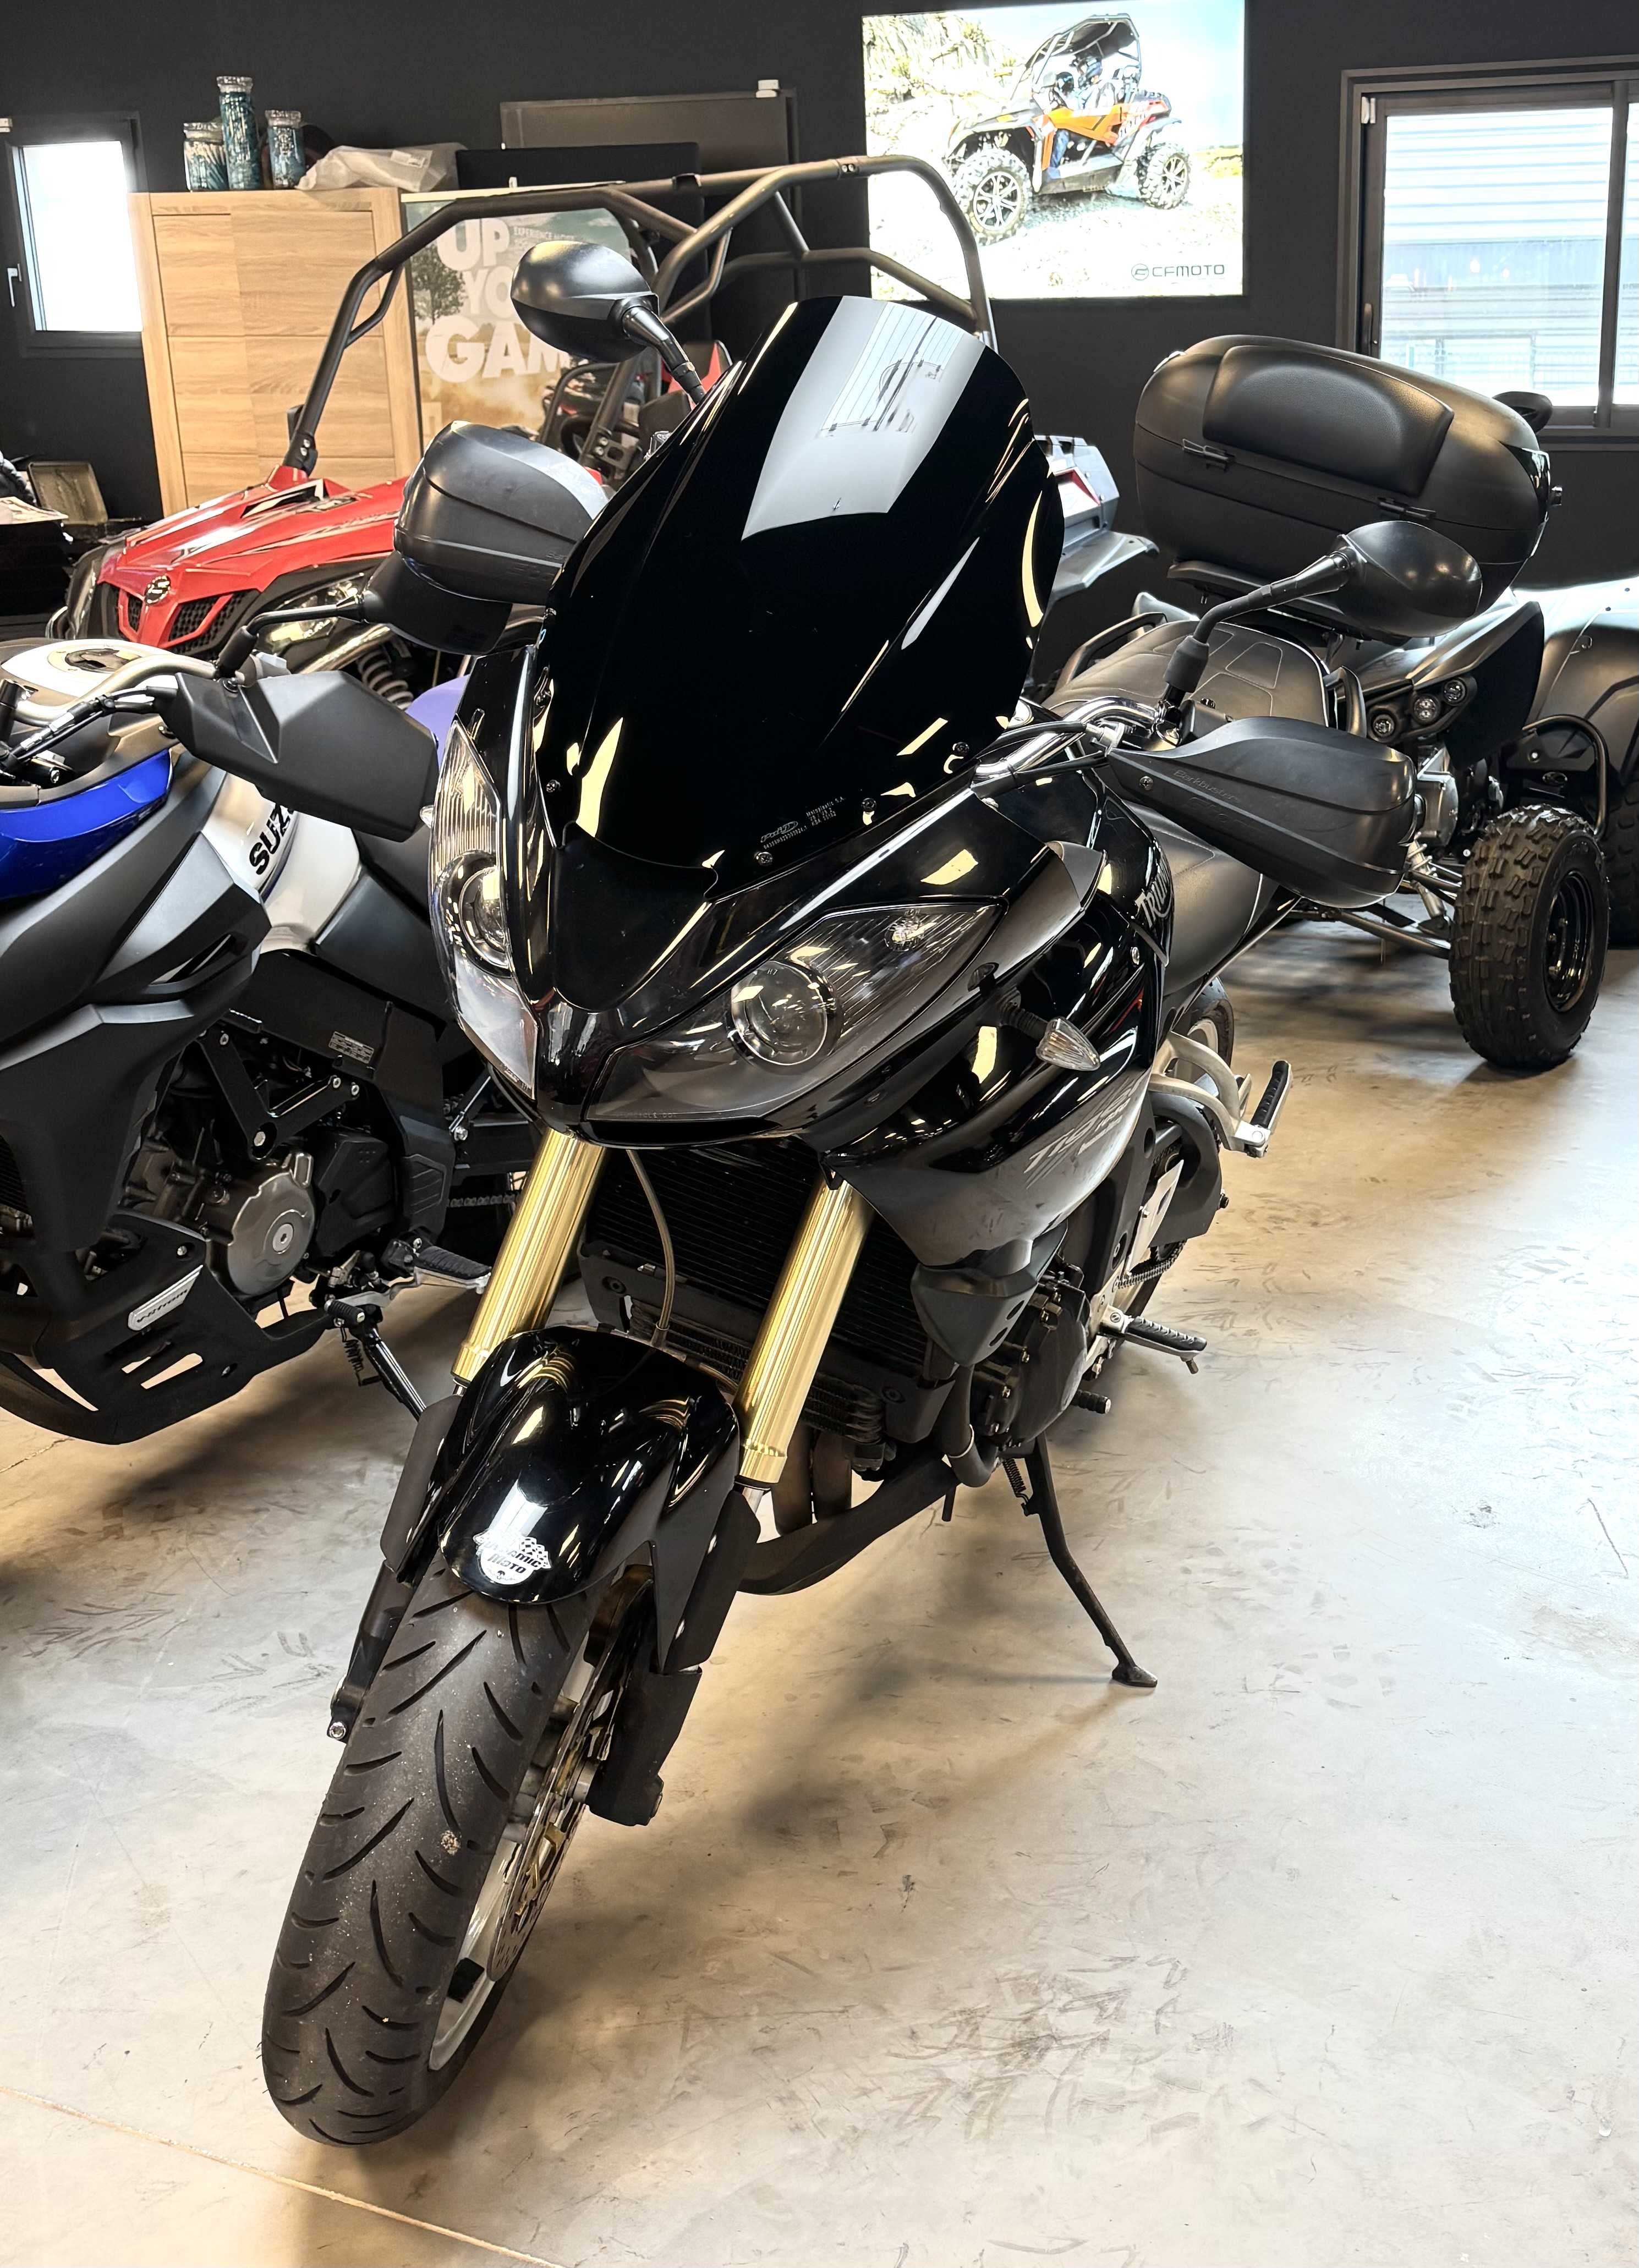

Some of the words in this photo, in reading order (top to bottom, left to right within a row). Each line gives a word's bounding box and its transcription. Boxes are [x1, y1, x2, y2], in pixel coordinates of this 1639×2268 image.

[437, 218, 511, 271] UP
[1152, 264, 1225, 277] CFMOTO
[249, 803, 294, 875] SUZ
